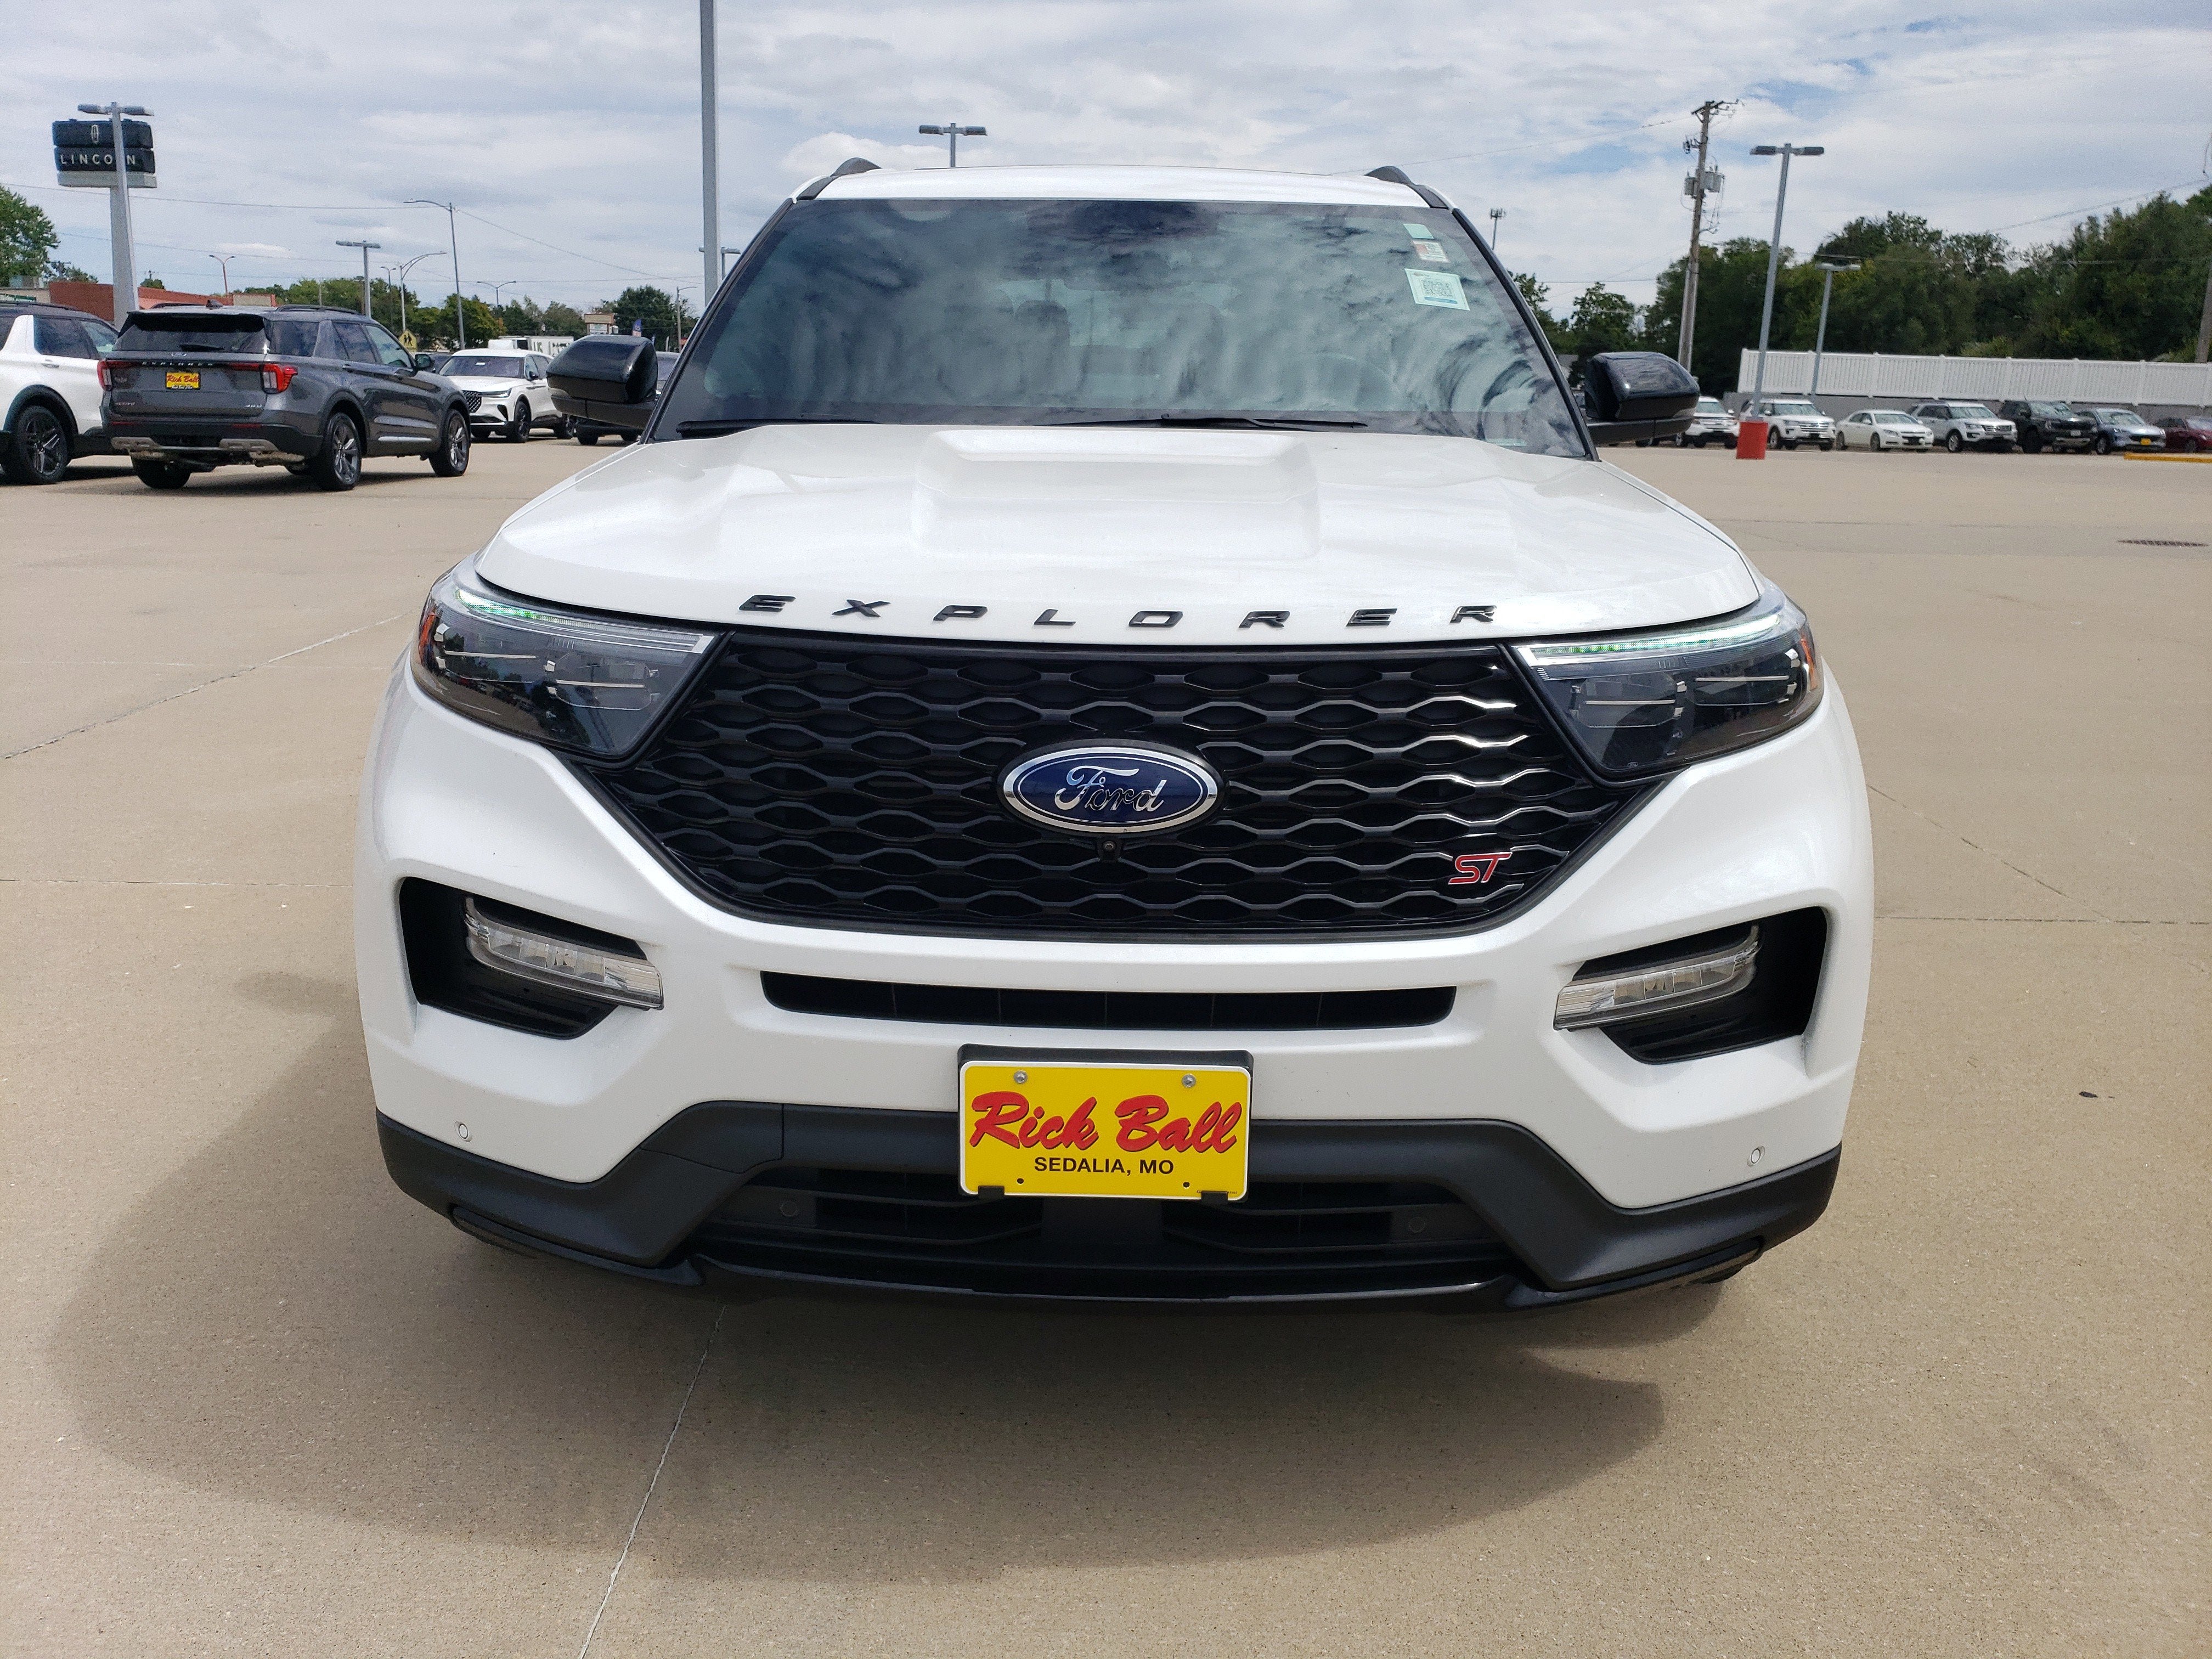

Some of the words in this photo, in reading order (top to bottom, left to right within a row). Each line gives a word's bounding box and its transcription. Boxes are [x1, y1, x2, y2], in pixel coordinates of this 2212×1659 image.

[60, 154, 136, 165] LINCON
[739, 595, 1497, 629] EXPLORER
[1054, 765, 1167, 812] Ford
[1448, 852, 1513, 885] ST
[969, 1091, 1099, 1150] Rick
[1115, 1094, 1242, 1153] Ball
[1034, 1157, 1131, 1176] SEDALIA,
[1139, 1159, 1174, 1175] MO
